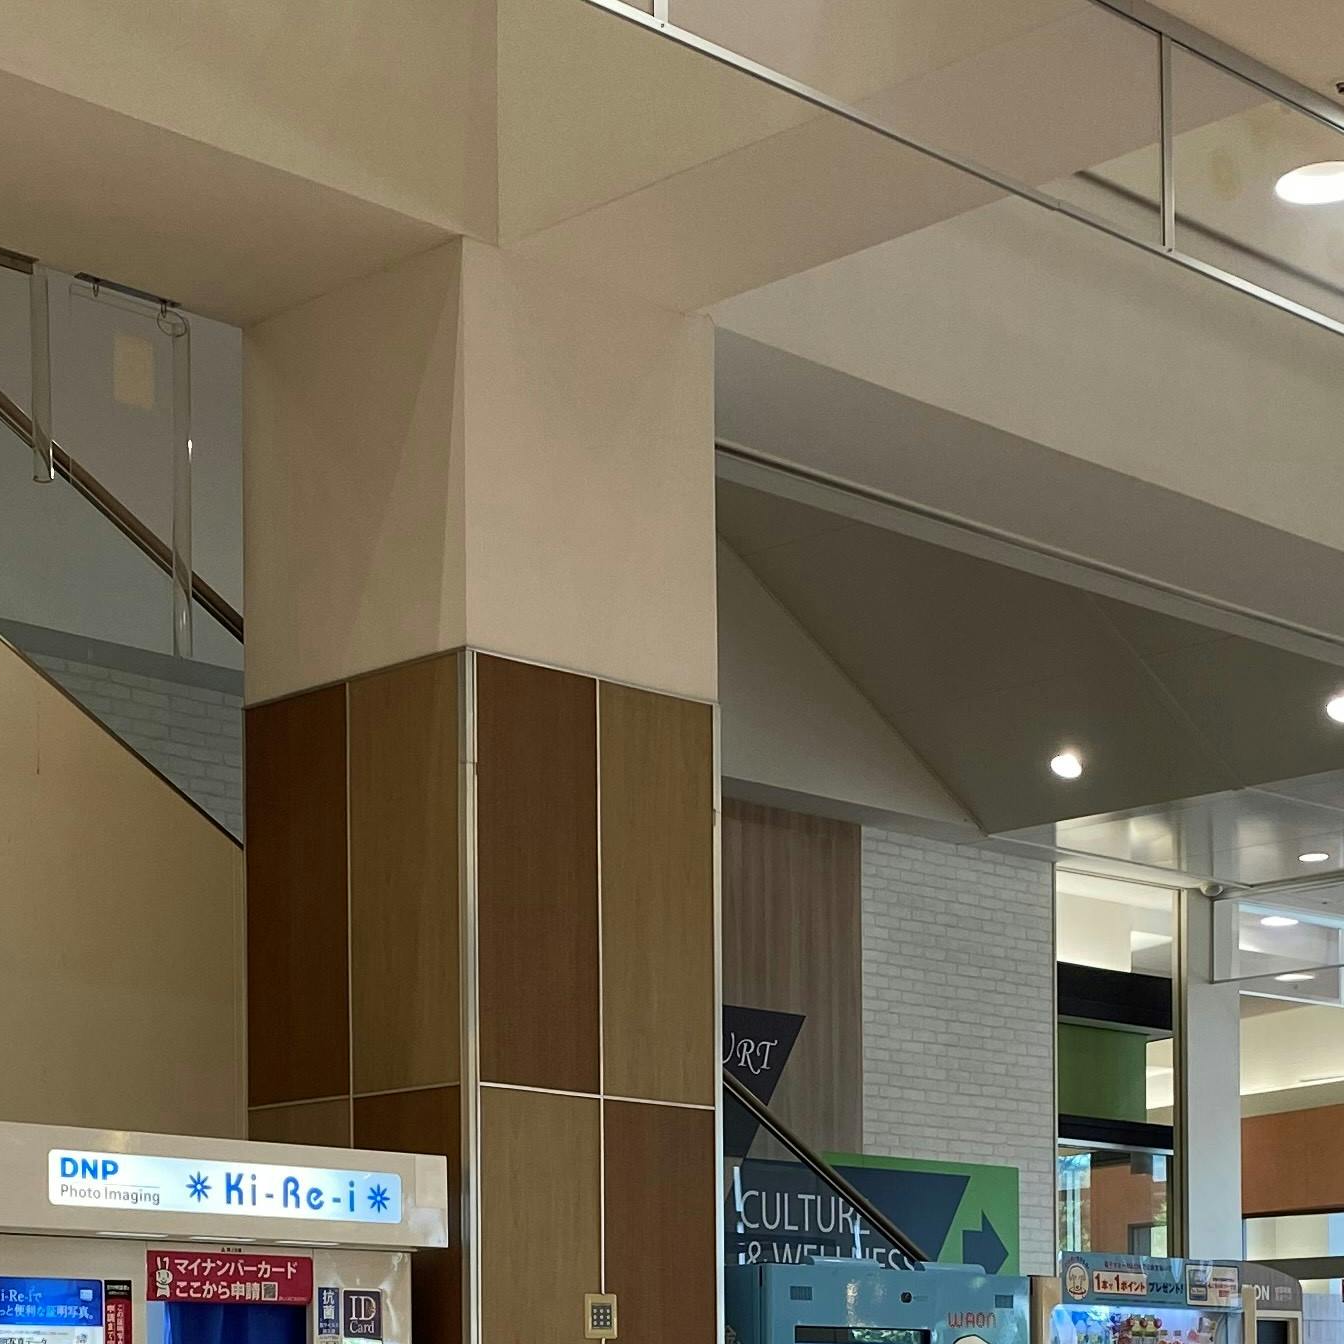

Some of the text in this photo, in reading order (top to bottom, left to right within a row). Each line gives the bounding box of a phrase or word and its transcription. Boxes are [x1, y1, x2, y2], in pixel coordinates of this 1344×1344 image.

[60, 1158, 119, 1180] DNP
[60, 1184, 160, 1206] Photo Imaging
[225, 1172, 355, 1213] Ki-Re-i
[174, 1257, 298, 1280] マイナンバーカード
[176, 1281, 260, 1301] ここから申請
[1148, 1282, 1184, 1295] プレゼント!
[323, 1290, 335, 1320] 抗菌
[349, 1295, 376, 1320] ID
[349, 1320, 375, 1334] Card
[947, 1311, 997, 1329] WAON
